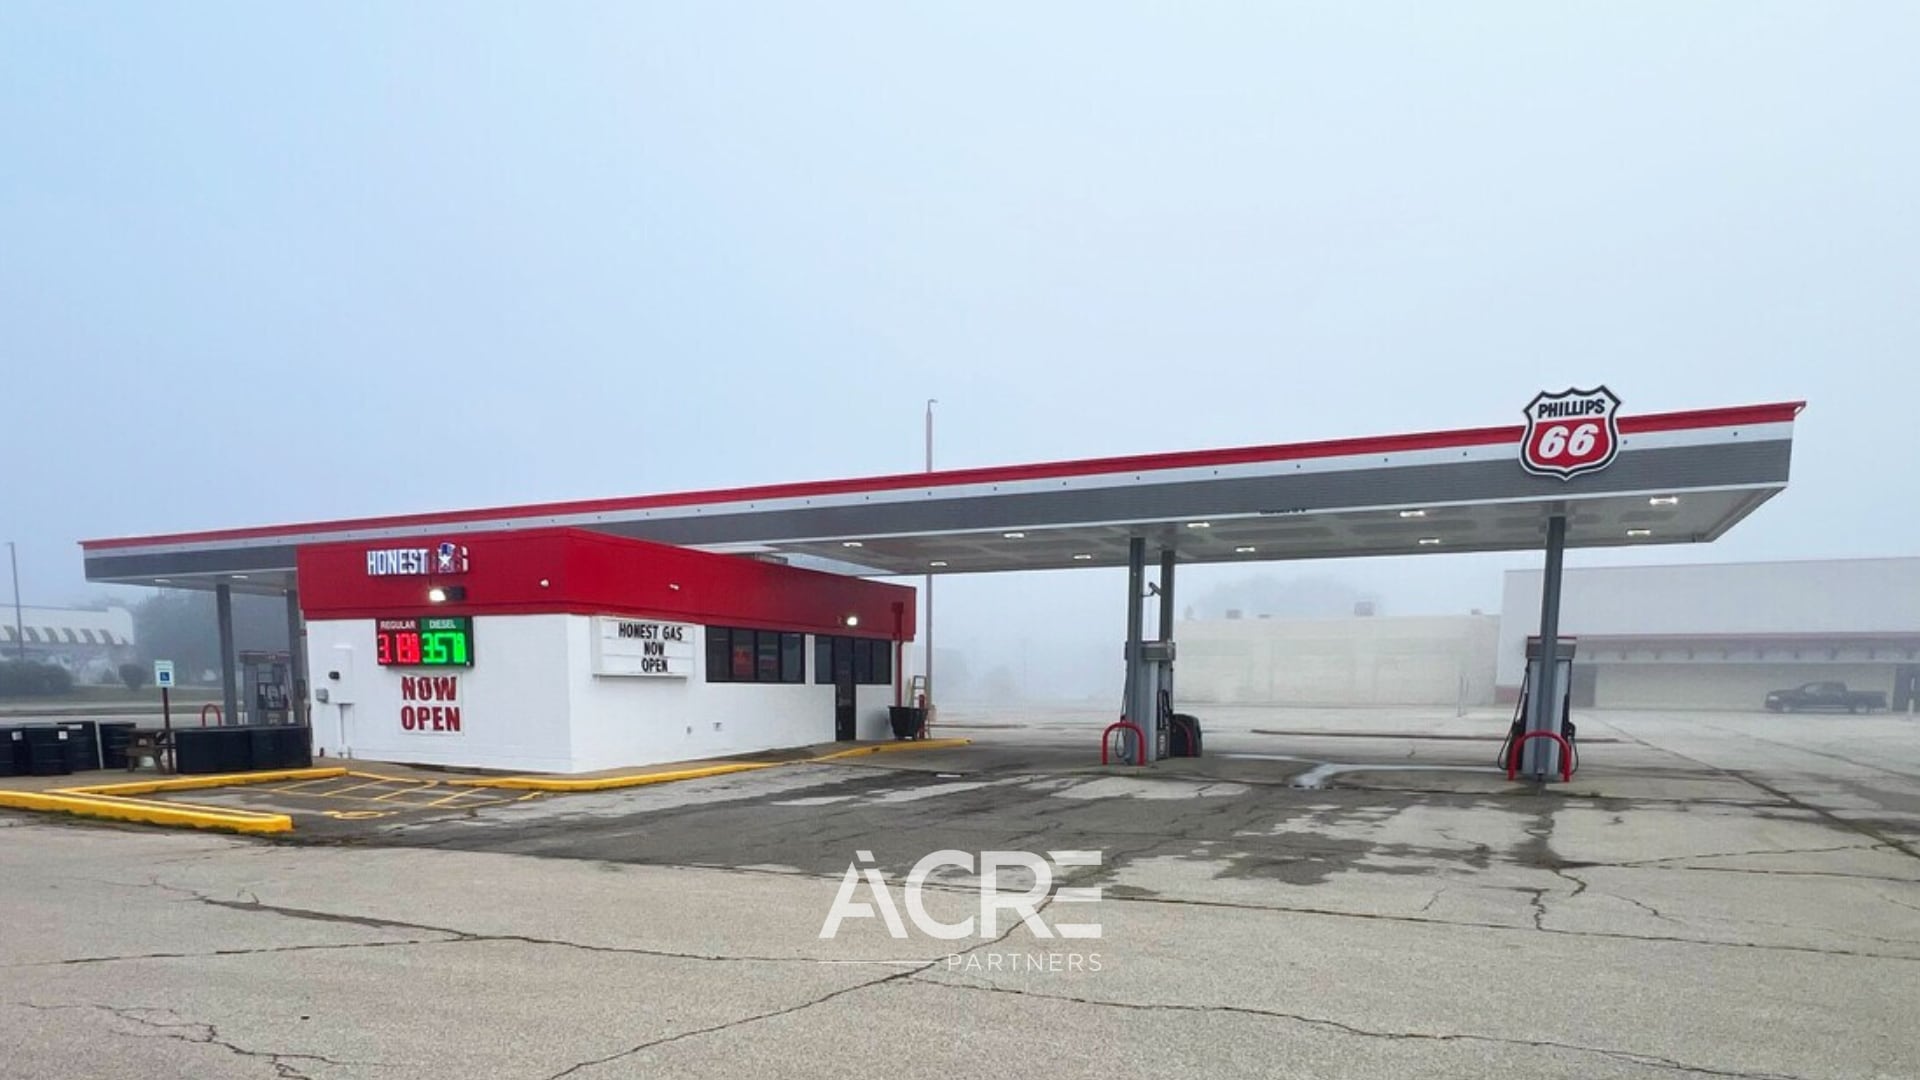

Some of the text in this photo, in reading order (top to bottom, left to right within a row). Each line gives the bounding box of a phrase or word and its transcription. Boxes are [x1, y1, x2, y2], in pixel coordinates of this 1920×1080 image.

[1538, 399, 1605, 418] PHILLIPS
[1539, 424, 1599, 458] 66
[367, 549, 429, 576] HONEST
[380, 619, 456, 630] REGULAR DIESEL
[618, 622, 683, 640] HONEST GAS
[643, 641, 664, 656] NOW
[641, 658, 668, 673] OPEN
[402, 676, 457, 701] NOW
[401, 705, 461, 731] OPEN
